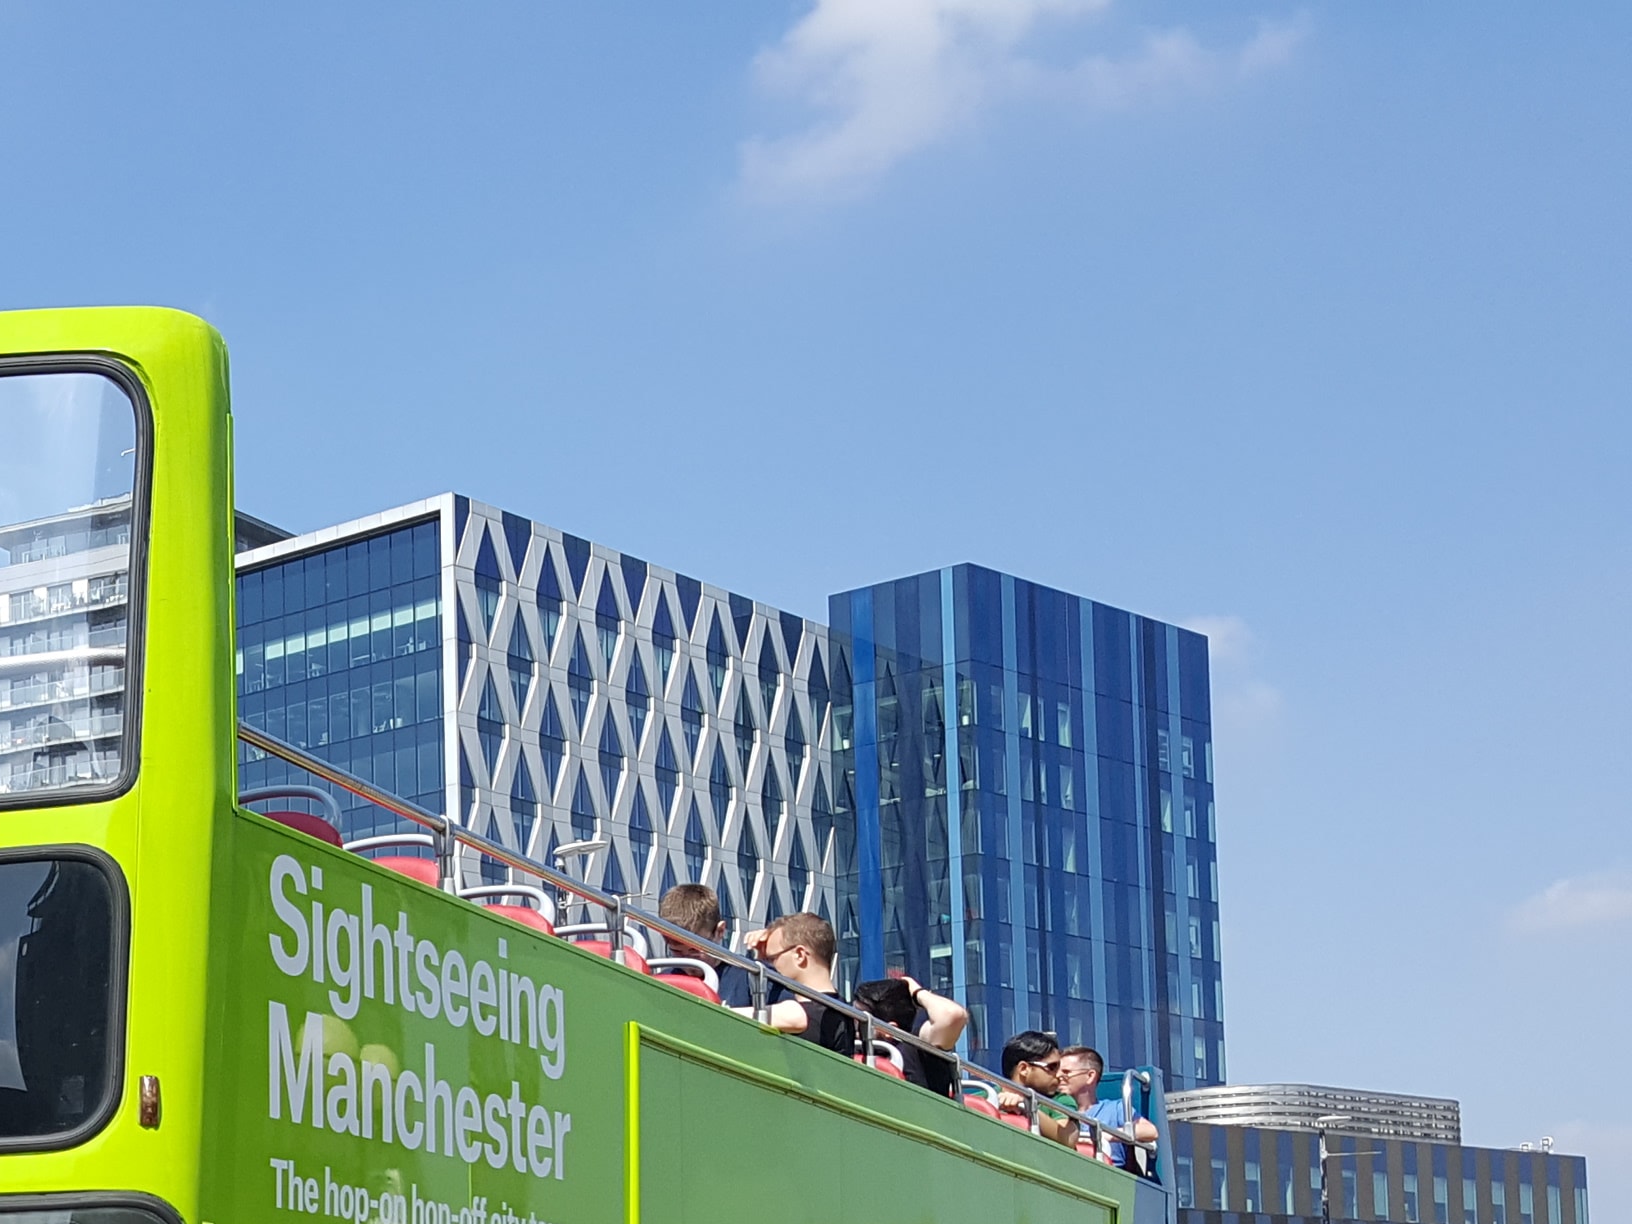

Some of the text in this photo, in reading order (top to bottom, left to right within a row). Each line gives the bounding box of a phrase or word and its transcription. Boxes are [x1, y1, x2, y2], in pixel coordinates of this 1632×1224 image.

[269, 854, 566, 1080] Sightseeing
[269, 1000, 572, 1181] Manchester
[270, 1158, 319, 1214] The
